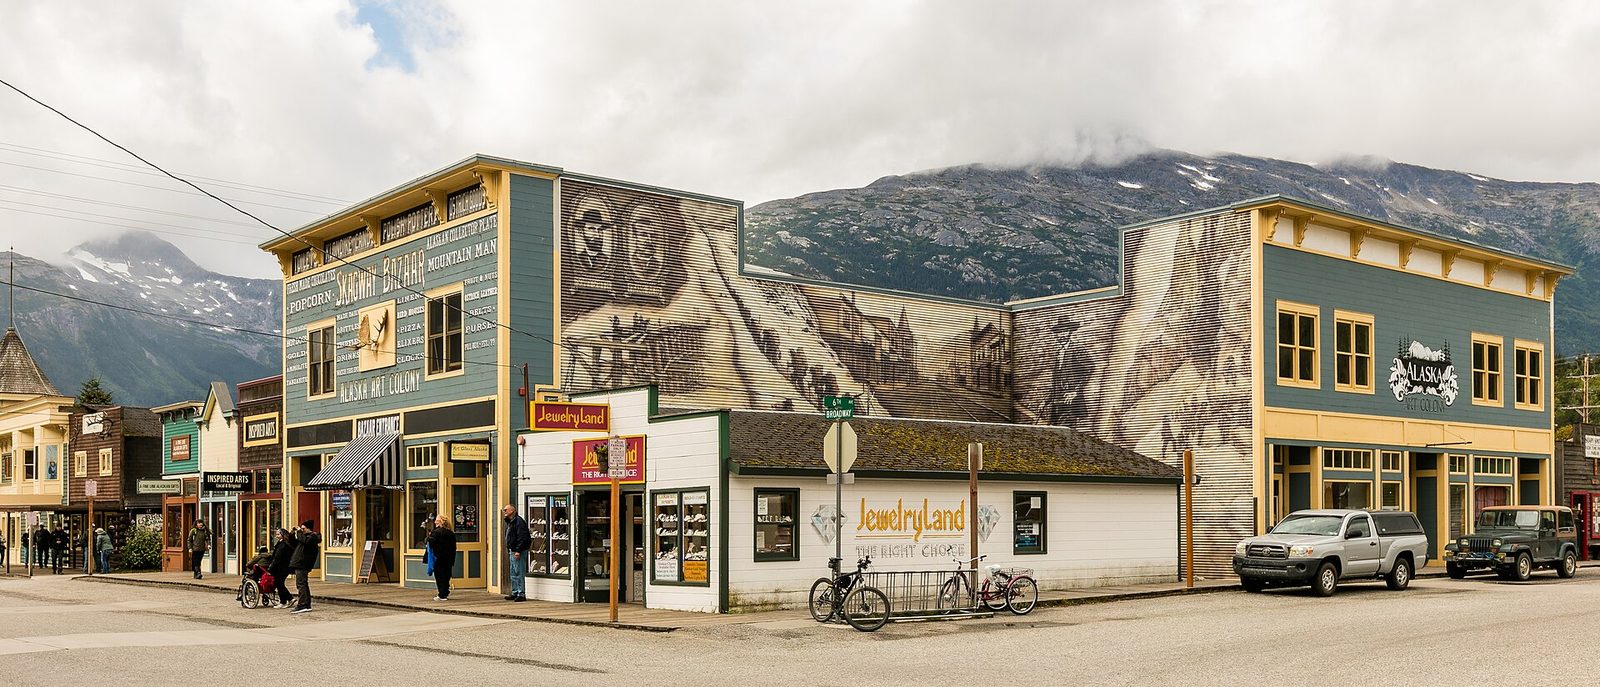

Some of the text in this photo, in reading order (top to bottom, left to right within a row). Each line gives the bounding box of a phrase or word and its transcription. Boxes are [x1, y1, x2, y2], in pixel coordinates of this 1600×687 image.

[427, 238, 497, 272] MOUNTAIN MAN
[335, 249, 426, 306] SKAGWAY BAZAAR
[289, 289, 332, 314] POPCORN
[399, 324, 422, 333] PIZZA
[288, 351, 306, 360] GOLD
[336, 352, 360, 362] DRINKS
[1407, 361, 1443, 384] ALASKA
[340, 368, 421, 404] ALASKA ART COLONY
[825, 409, 852, 419] BROADWAY
[248, 421, 276, 439] INSPIRED ARTS
[207, 474, 234, 483] INSPIRED
[234, 474, 249, 483] ARTS
[581, 470, 593, 479] THE
[856, 543, 965, 559] THE RIGHT CHOICE
